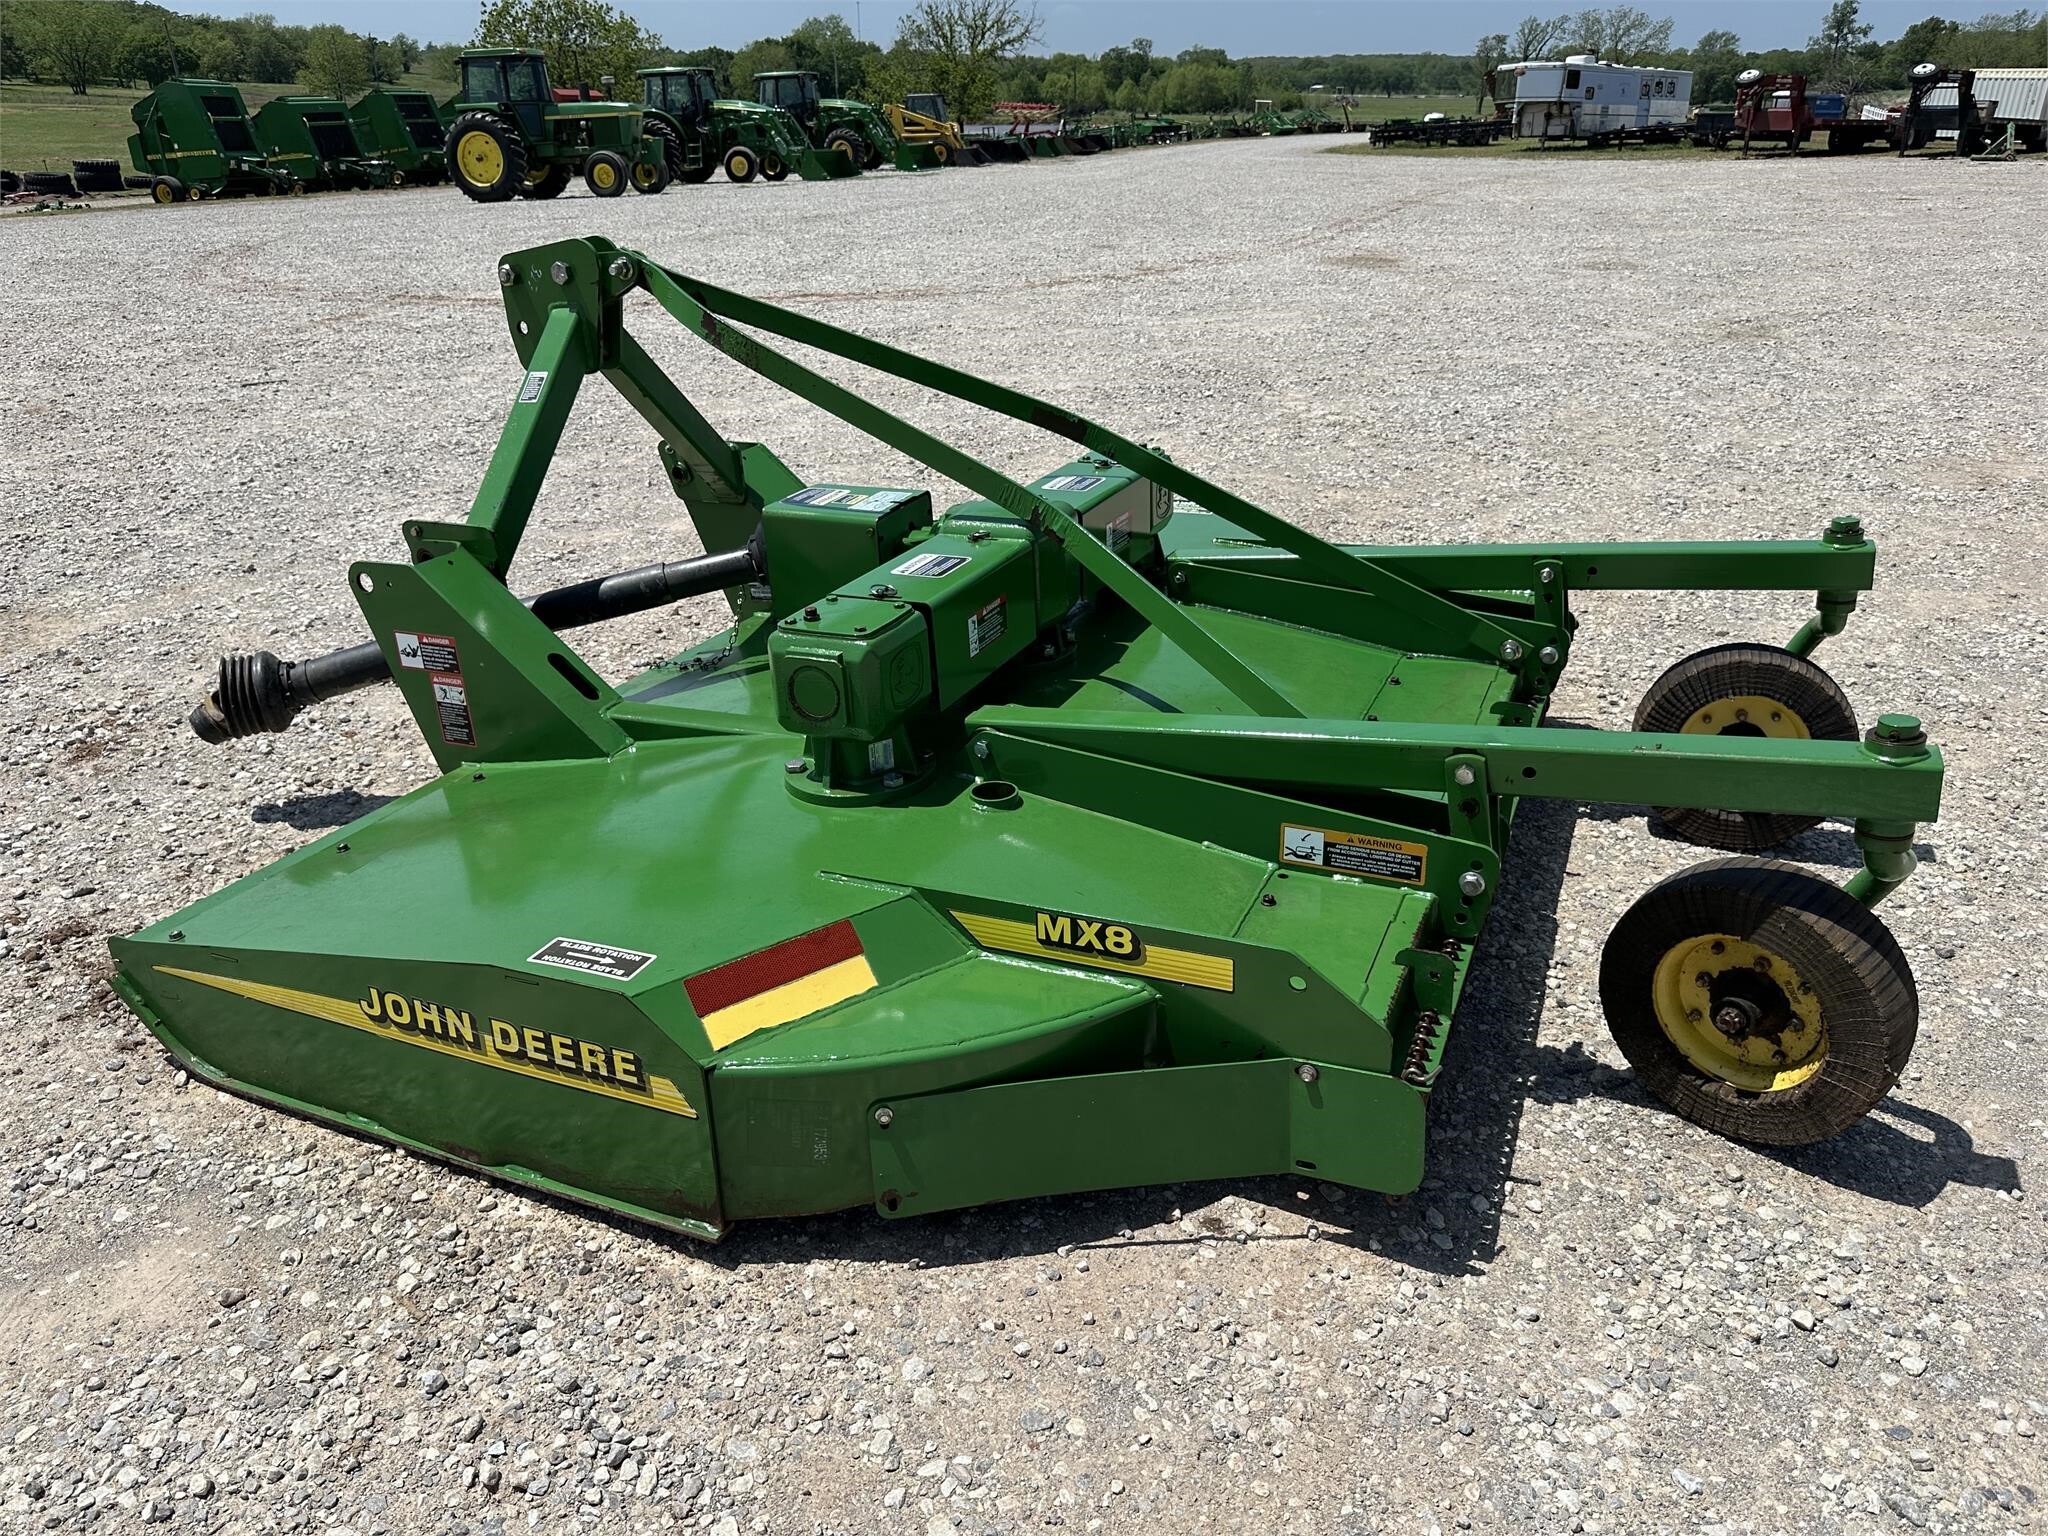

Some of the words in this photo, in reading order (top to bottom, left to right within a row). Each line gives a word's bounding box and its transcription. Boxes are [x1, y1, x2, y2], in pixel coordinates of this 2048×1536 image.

[438, 676, 462, 686] DANGER
[1358, 837, 1402, 850] WARNING
[1036, 911, 1136, 957] MX8
[560, 941, 593, 951] BLADE
[592, 946, 642, 962] ROTATION
[542, 954, 591, 969] ROTATION
[590, 962, 626, 976] BLADE
[359, 985, 477, 1046] JOHN
[488, 1017, 642, 1087] DEERE
